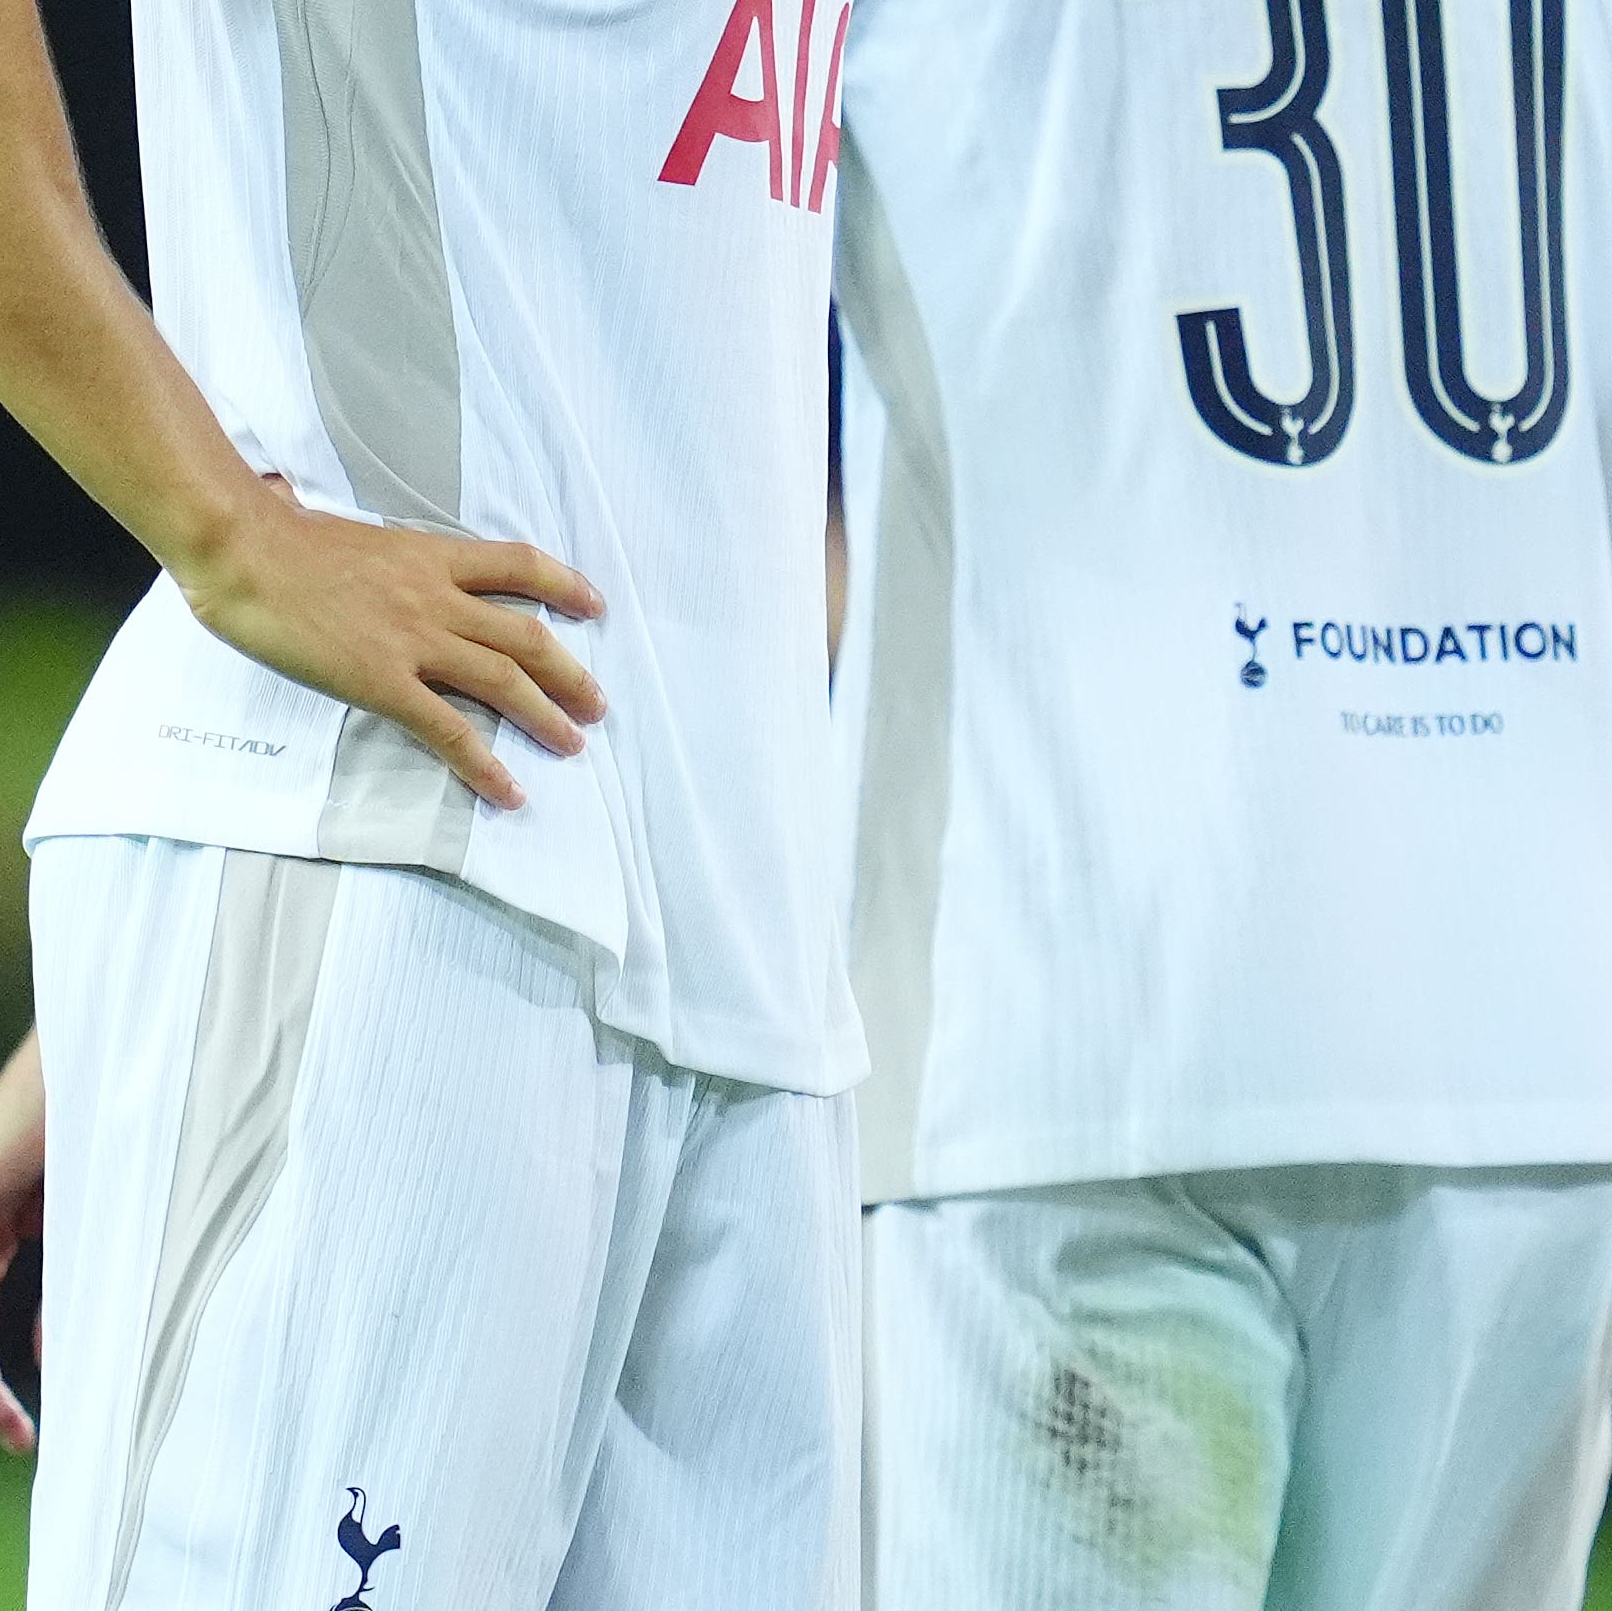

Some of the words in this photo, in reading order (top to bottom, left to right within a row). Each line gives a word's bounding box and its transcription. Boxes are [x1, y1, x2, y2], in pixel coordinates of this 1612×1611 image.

[1291, 621, 1579, 665] FOUNDATION
[1362, 712, 1406, 737] CARE
[1410, 714, 1431, 737] IS
[1436, 714, 1466, 736] TO
[1469, 712, 1505, 736] DO
